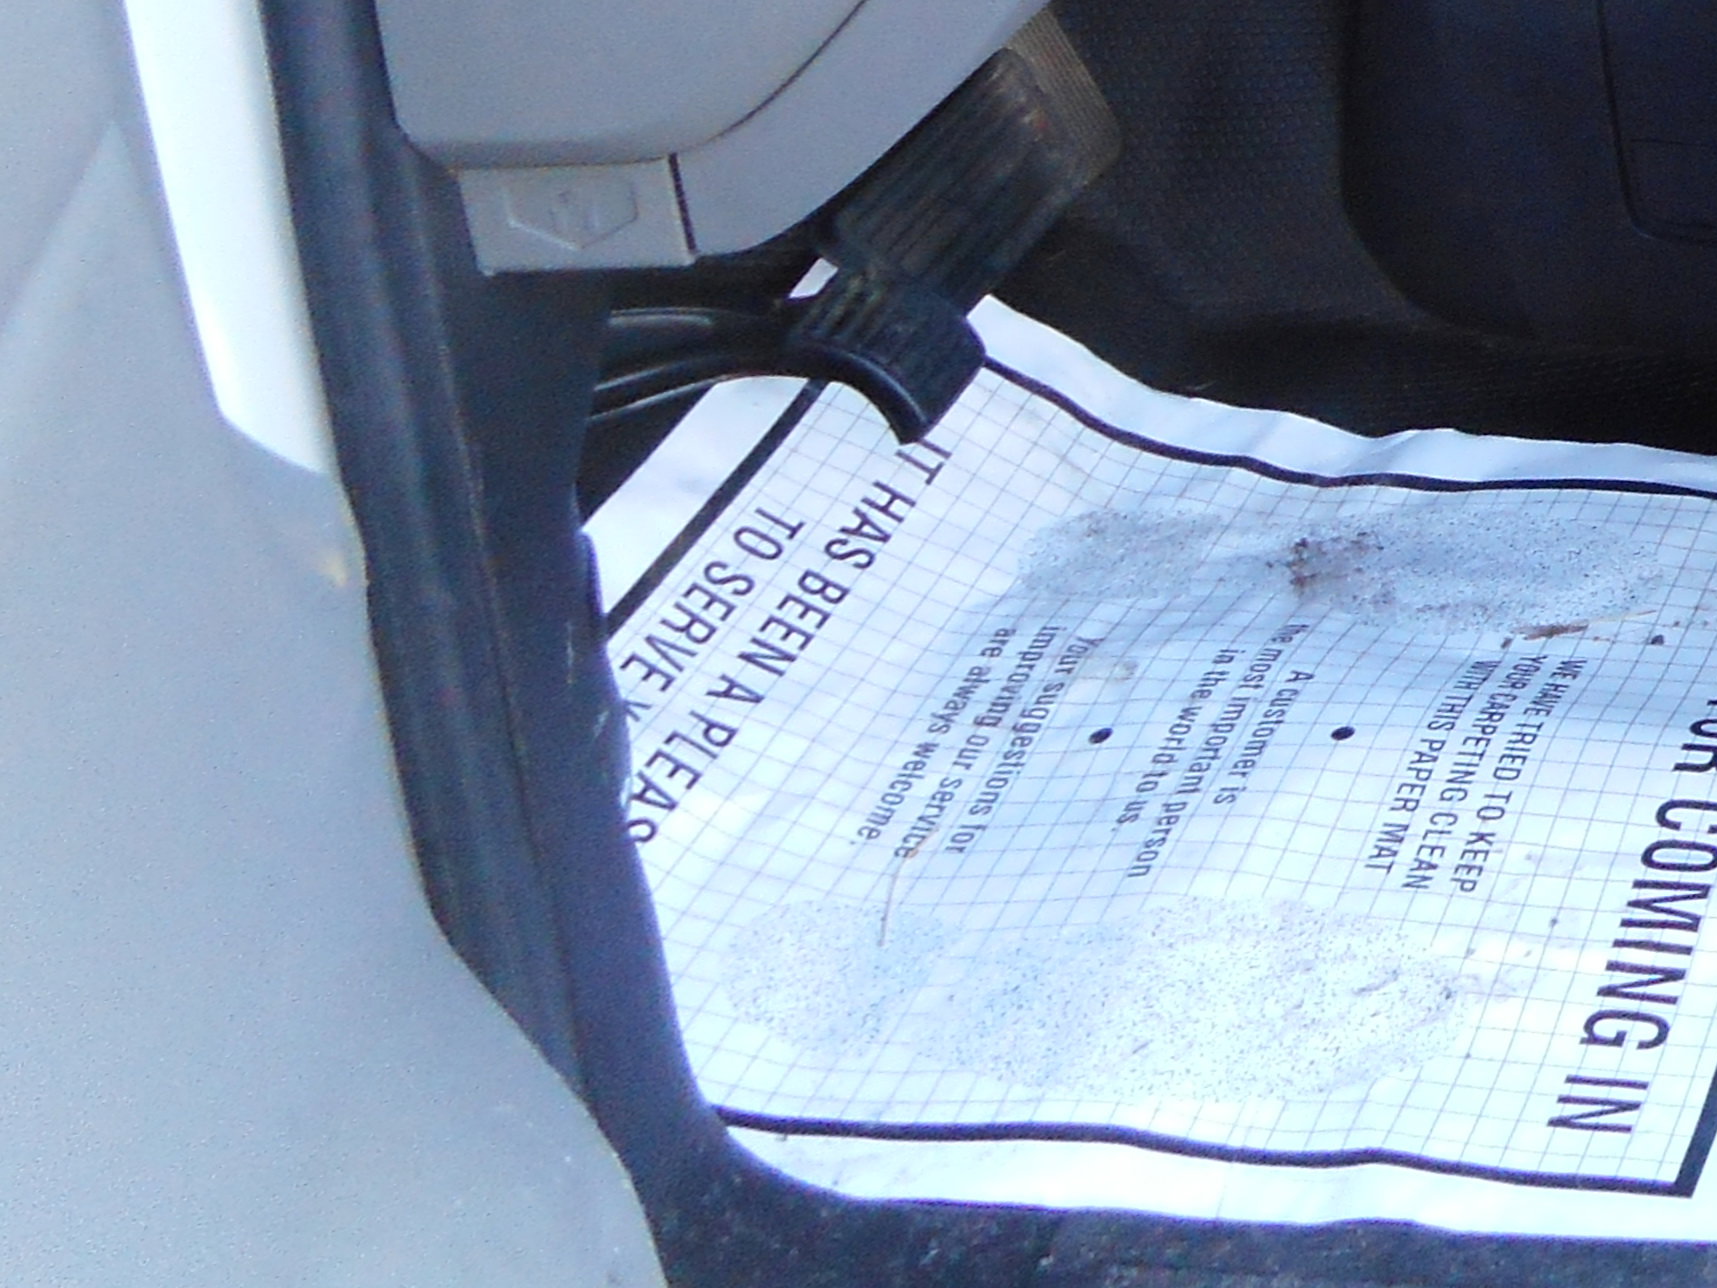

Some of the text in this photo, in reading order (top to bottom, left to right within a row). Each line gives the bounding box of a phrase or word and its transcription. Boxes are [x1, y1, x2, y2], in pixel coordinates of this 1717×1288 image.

[894, 437, 953, 486] IT
[823, 480, 917, 573] HAS
[620, 508, 803, 692] TO SERVE
[736, 569, 849, 676] BEEN
[980, 626, 1017, 659] are
[1213, 647, 1244, 662] in
[1238, 648, 1282, 690] most
[707, 674, 764, 706] A
[928, 665, 994, 735] always
[1191, 672, 1226, 698] the
[893, 624, 1066, 860] improving our service
[944, 637, 1104, 855] Your suggestions for
[1152, 706, 1200, 763] world
[1176, 696, 1260, 796] important
[1213, 670, 1313, 807] A customer is
[1365, 661, 1499, 875] WITH THIS PAPER MAT
[1402, 654, 1547, 890] YOUR CARPETING CLEAN
[1135, 771, 1167, 792] to
[1448, 660, 1586, 894] WE HAVE TRIED TO KEEP
[1128, 803, 1187, 878] person
[1546, 1074, 1650, 1134] IN
